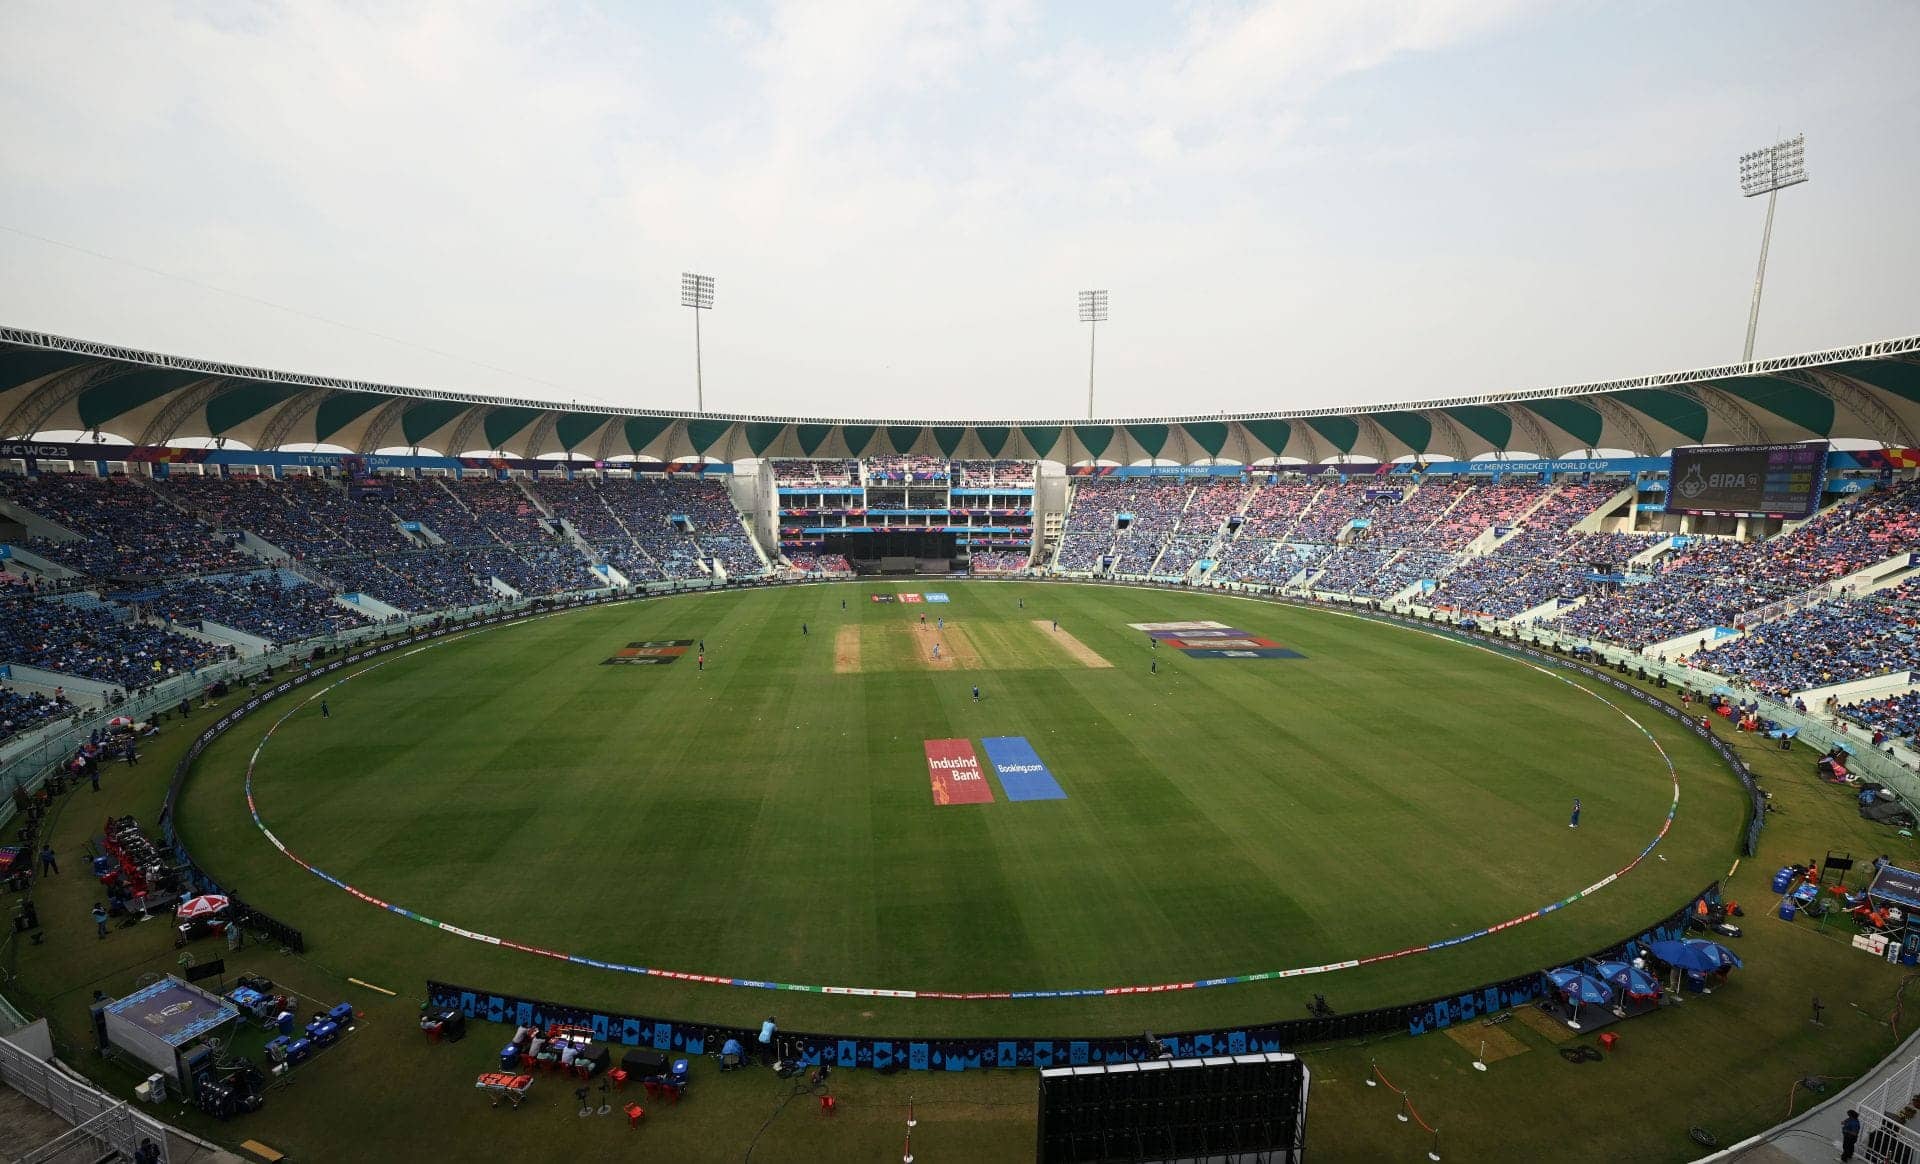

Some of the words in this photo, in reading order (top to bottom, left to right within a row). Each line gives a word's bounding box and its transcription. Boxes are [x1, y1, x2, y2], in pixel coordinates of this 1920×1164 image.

[1, 445, 69, 456] #CWC23
[311, 456, 344, 464] TAKE
[1485, 463, 1510, 471] MEN'S
[1552, 462, 1585, 470] WORLD
[1588, 461, 1608, 469] CUP
[1709, 473, 1746, 487] BIRA
[929, 756, 977, 769] IndusInd
[997, 764, 1043, 773] Booking.com
[952, 769, 981, 781] Bank
